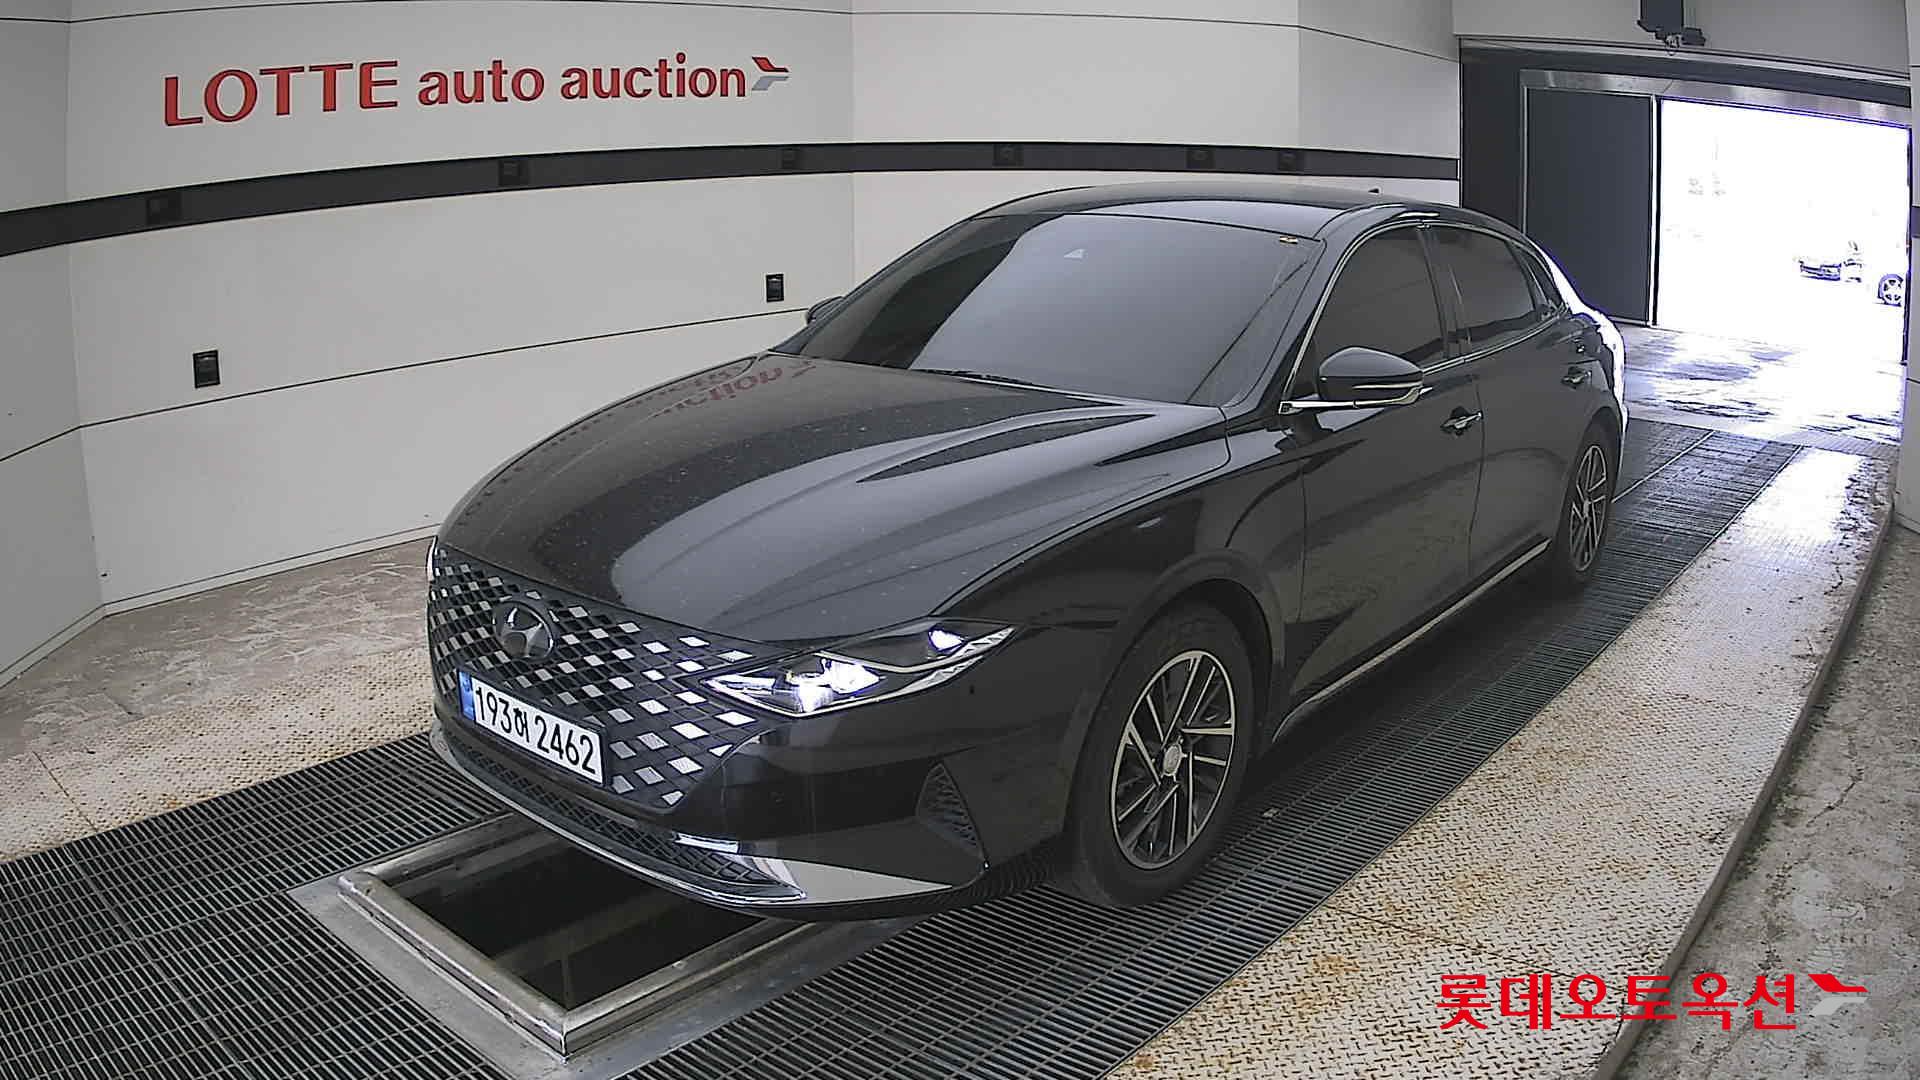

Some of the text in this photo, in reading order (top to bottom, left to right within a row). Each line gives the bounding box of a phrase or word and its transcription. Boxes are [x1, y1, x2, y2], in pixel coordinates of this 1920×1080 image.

[164, 53, 746, 127] LOTTE auto auction
[475, 686, 596, 775] 193허 2462
